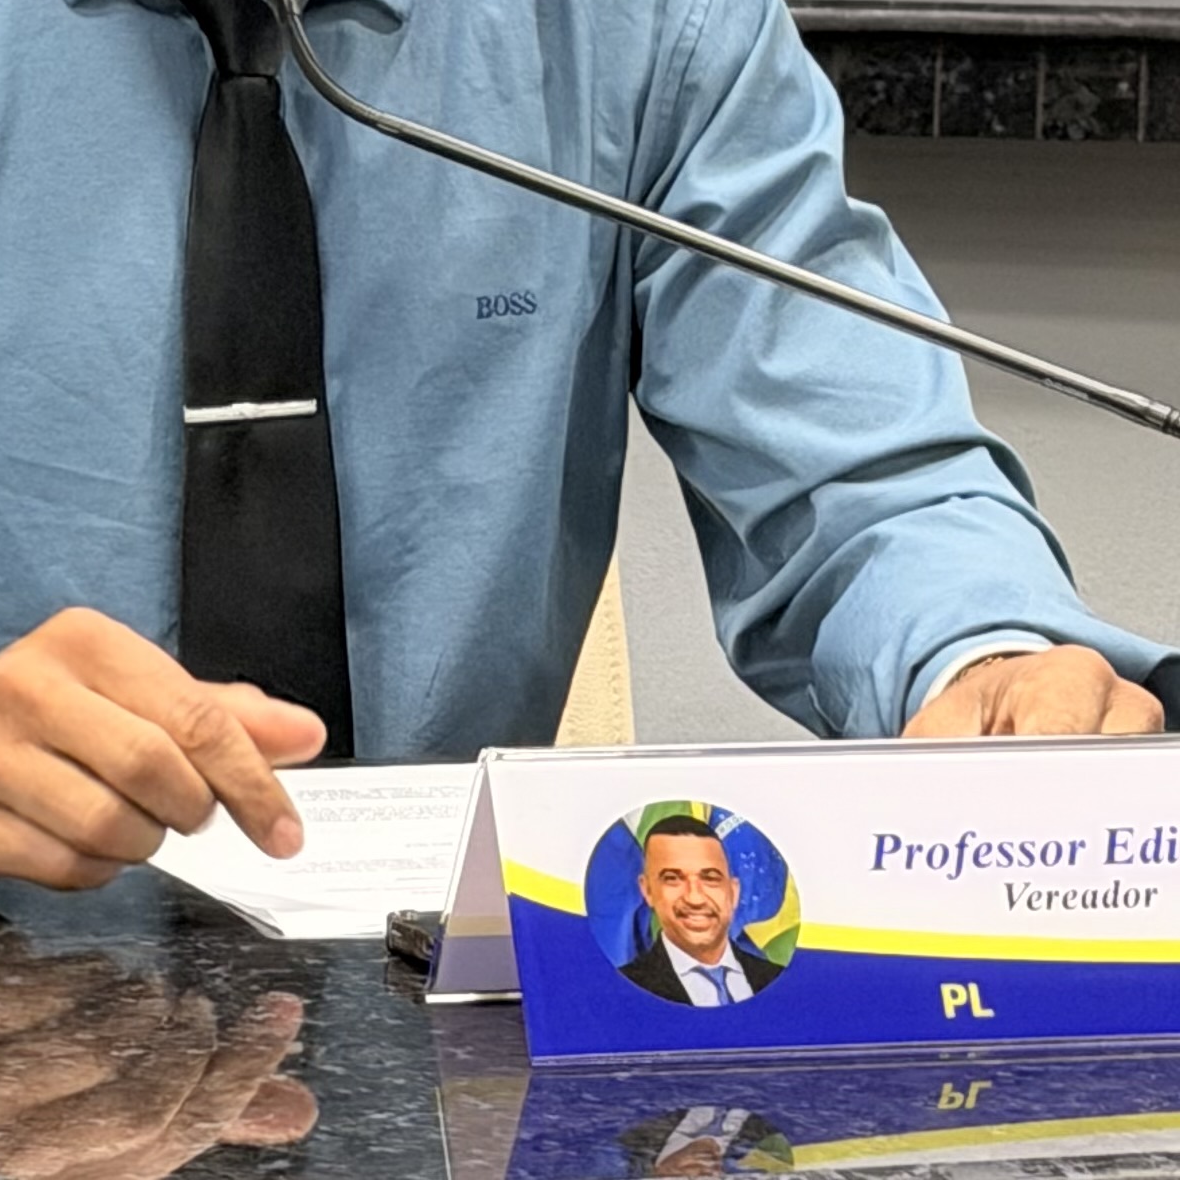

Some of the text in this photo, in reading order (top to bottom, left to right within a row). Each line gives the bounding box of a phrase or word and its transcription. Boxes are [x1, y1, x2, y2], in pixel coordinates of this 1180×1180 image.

[476, 289, 537, 320] BOSS
[869, 830, 1086, 880] Professor
[1004, 880, 1158, 911] Vereador
[940, 982, 995, 1019] PL
